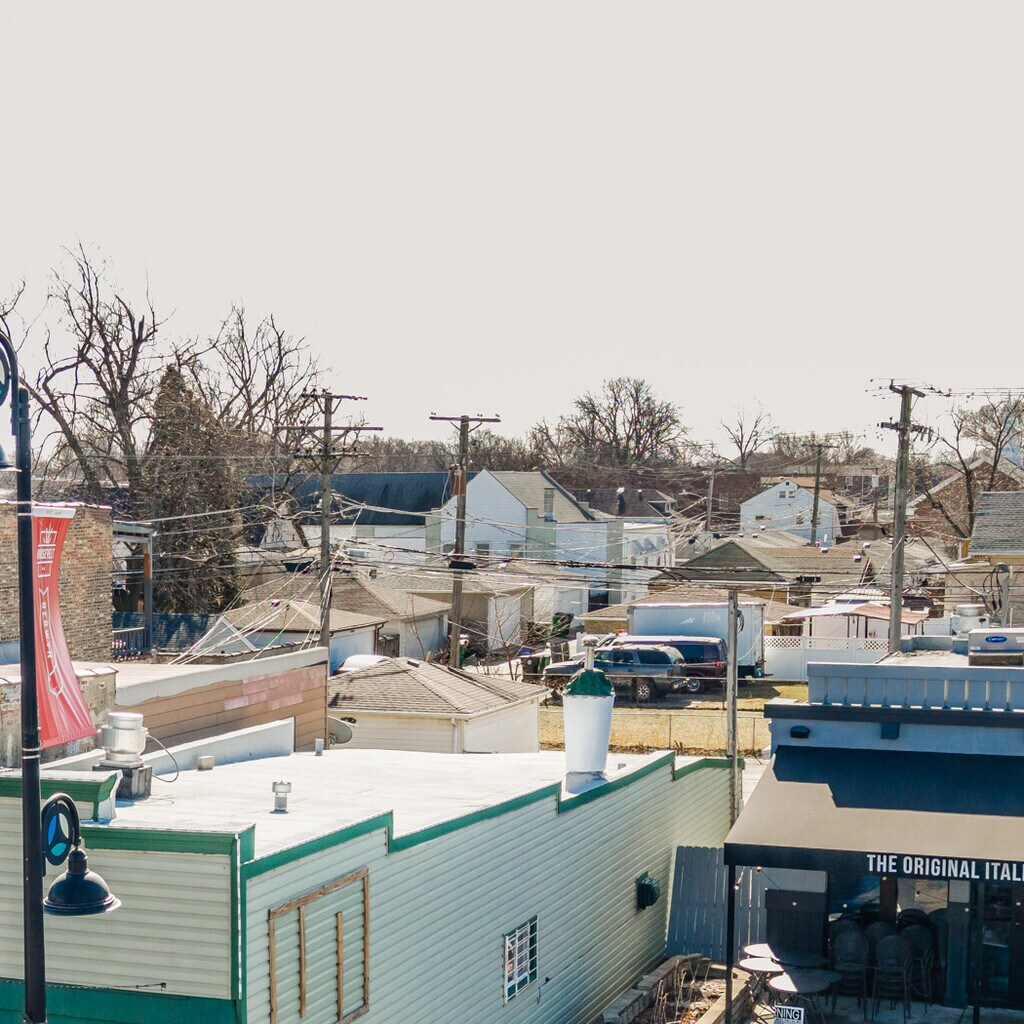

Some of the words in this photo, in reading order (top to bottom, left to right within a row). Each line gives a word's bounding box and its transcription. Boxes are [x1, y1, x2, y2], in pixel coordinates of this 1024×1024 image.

[41, 601, 53, 659] BERWYN
[866, 854, 897, 873] THE
[902, 856, 980, 879] ORIGINAL
